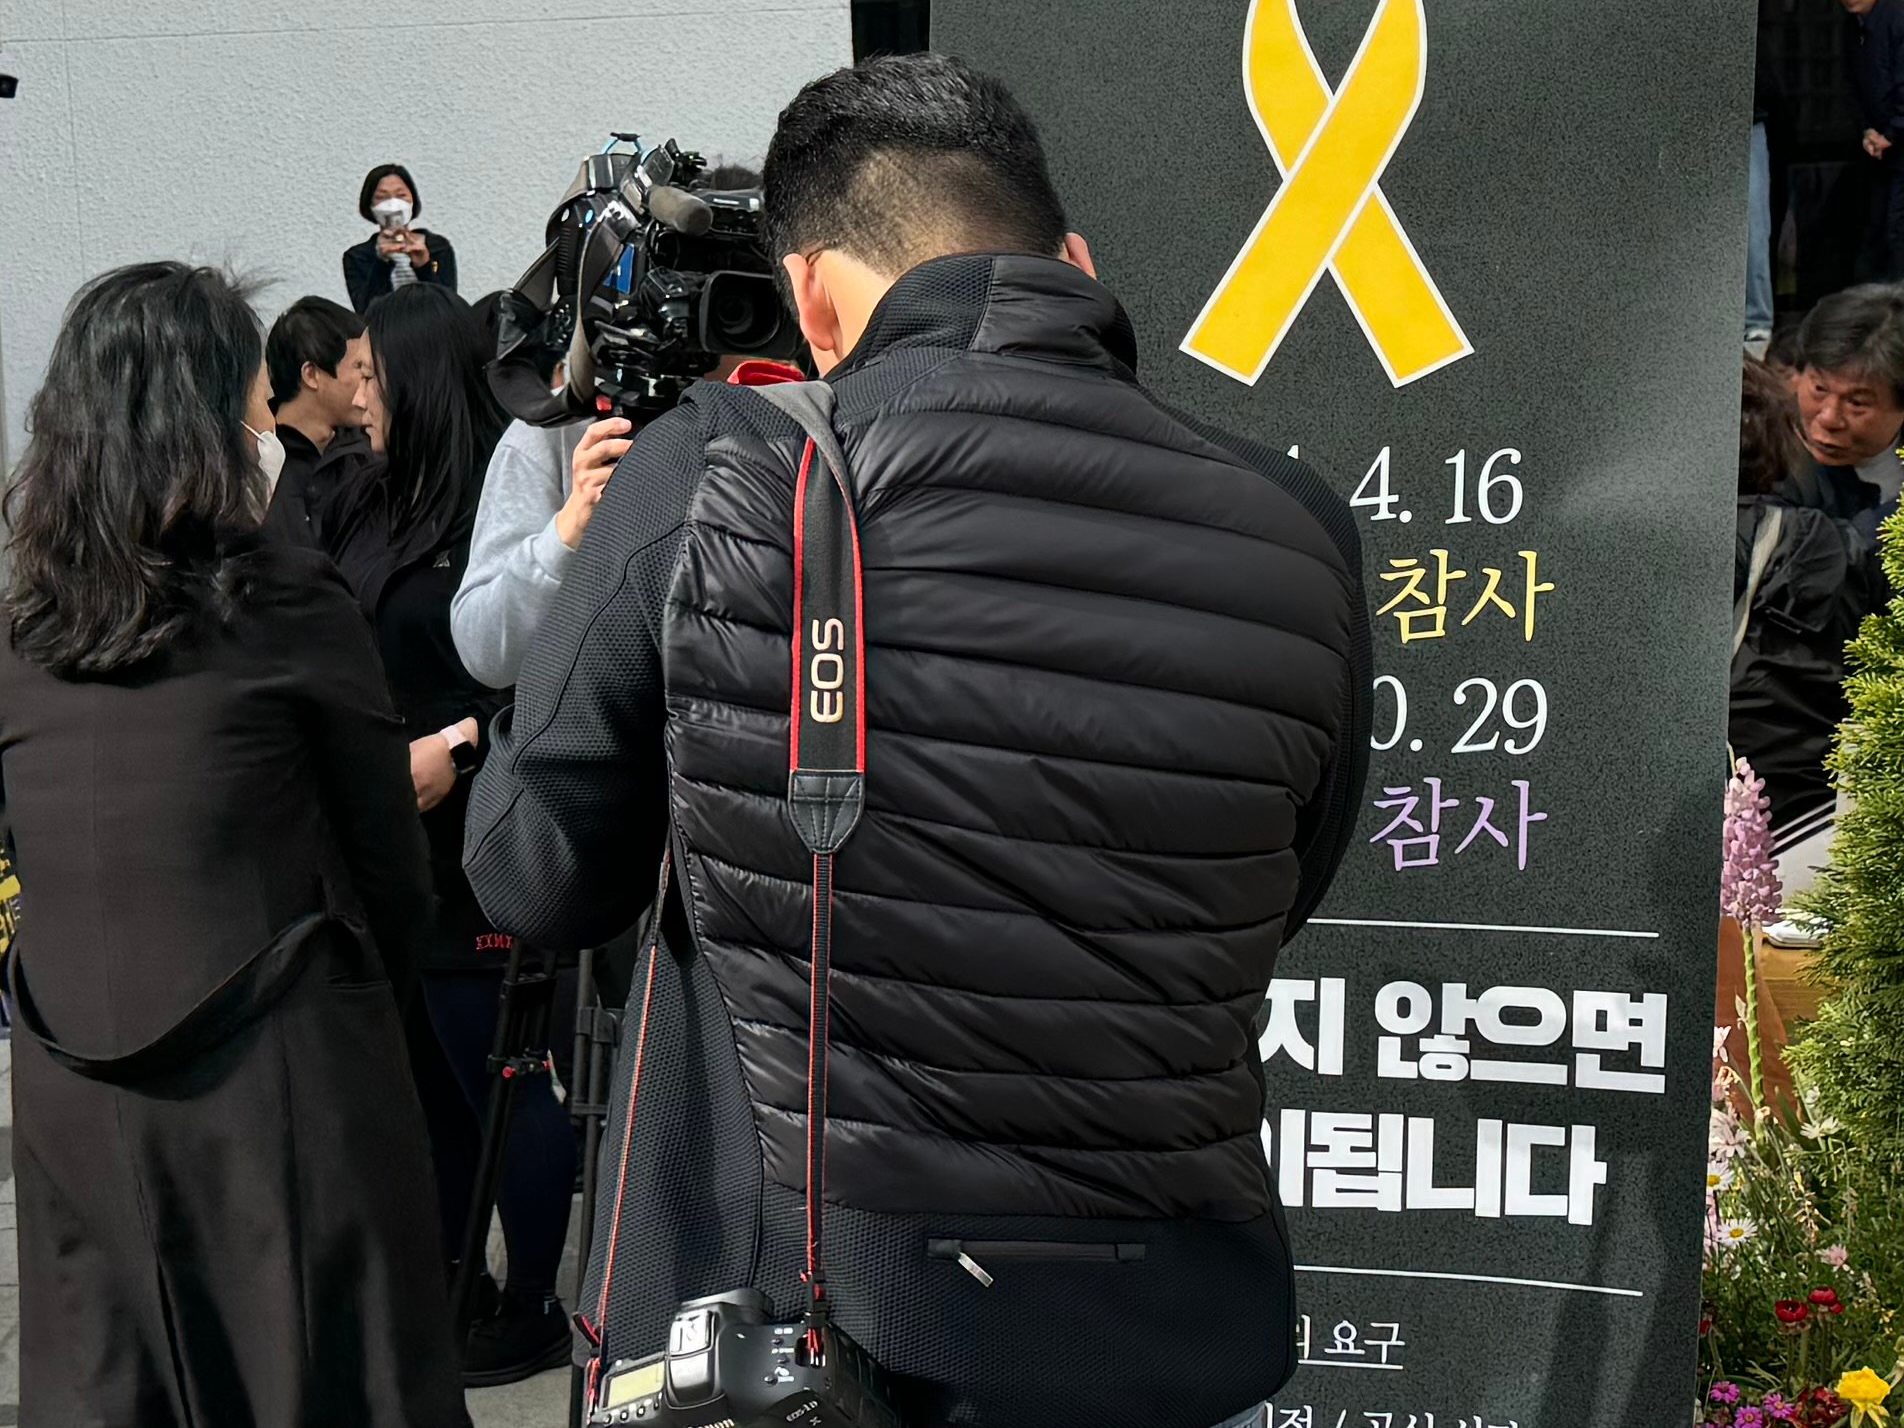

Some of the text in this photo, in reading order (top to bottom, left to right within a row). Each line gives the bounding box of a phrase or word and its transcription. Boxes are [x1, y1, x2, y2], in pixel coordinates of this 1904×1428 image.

[1375, 547, 1556, 645] 참사
[809, 617, 845, 723] EOS
[1451, 676, 1549, 756] 29
[1368, 776, 1549, 872] 참사
[1374, 980, 1668, 1095] 않으면
[1323, 1320, 1407, 1366] 요구
